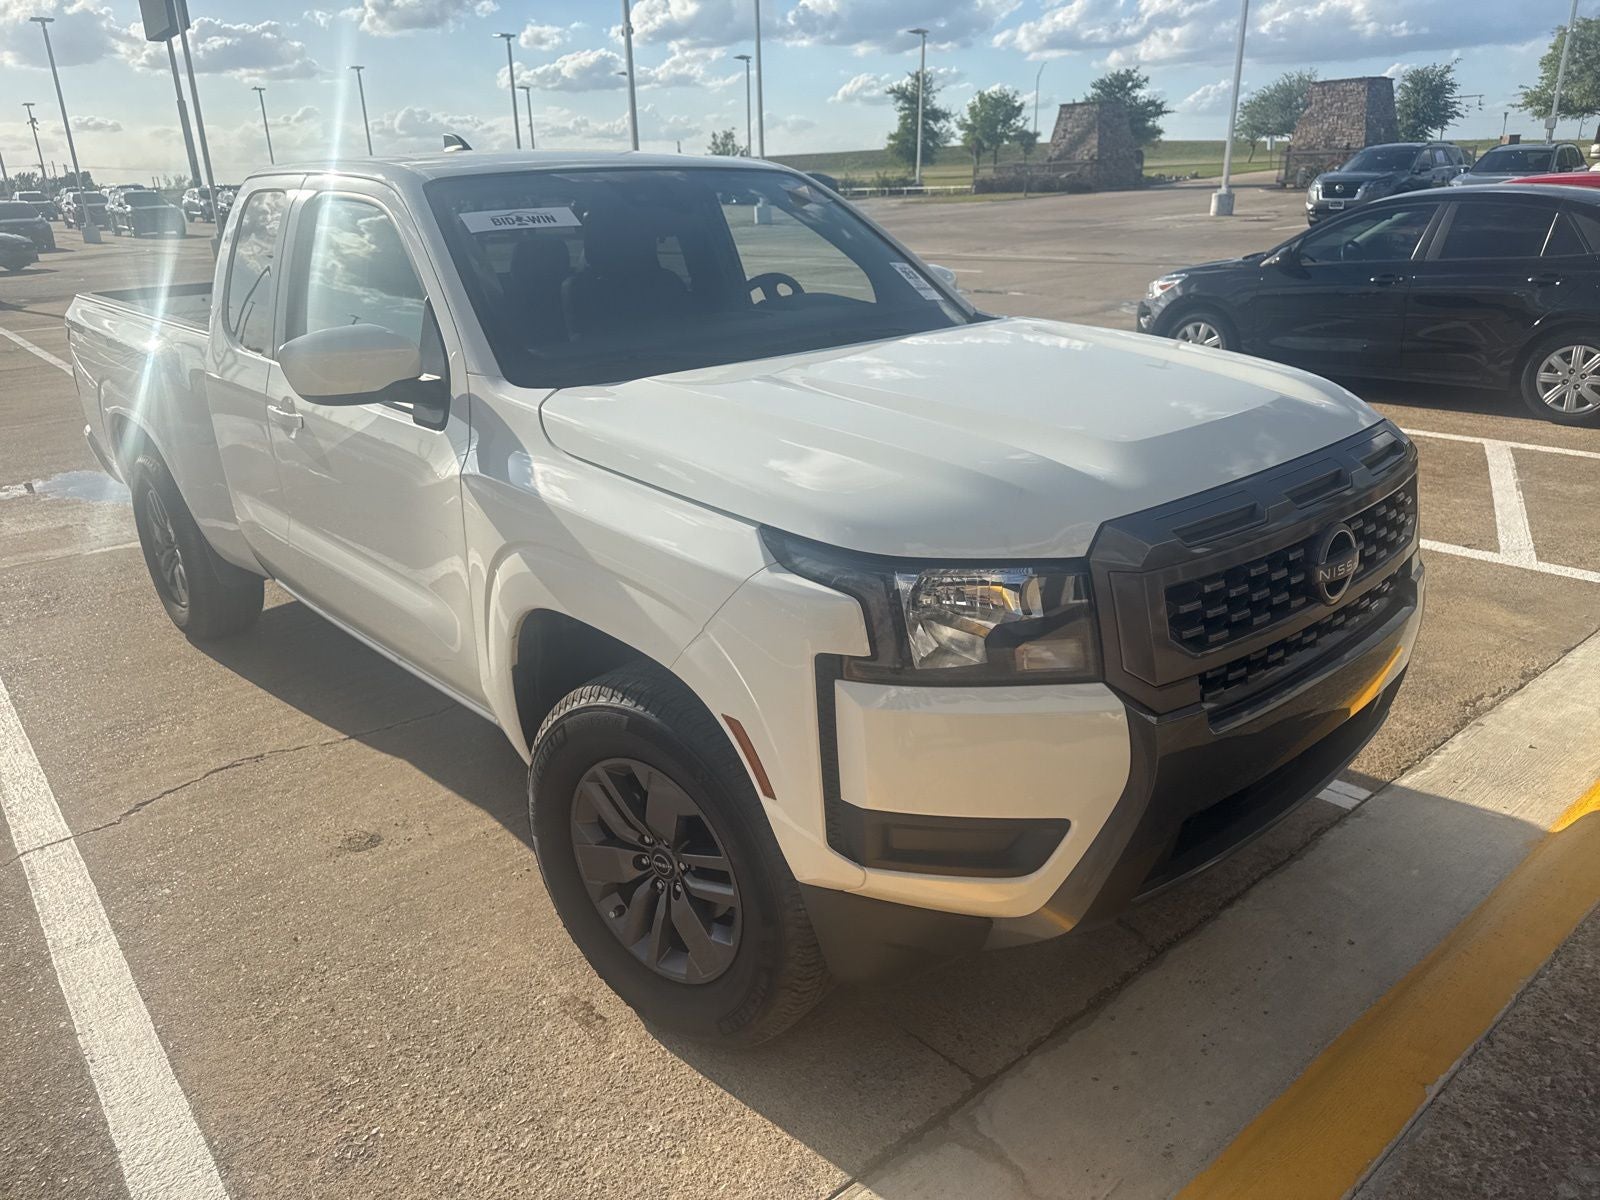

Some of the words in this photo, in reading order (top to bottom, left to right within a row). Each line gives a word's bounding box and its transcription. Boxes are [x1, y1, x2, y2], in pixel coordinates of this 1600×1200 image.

[491, 217, 516, 226] BID
[527, 215, 557, 224] WIN
[1319, 560, 1358, 581] NISS
